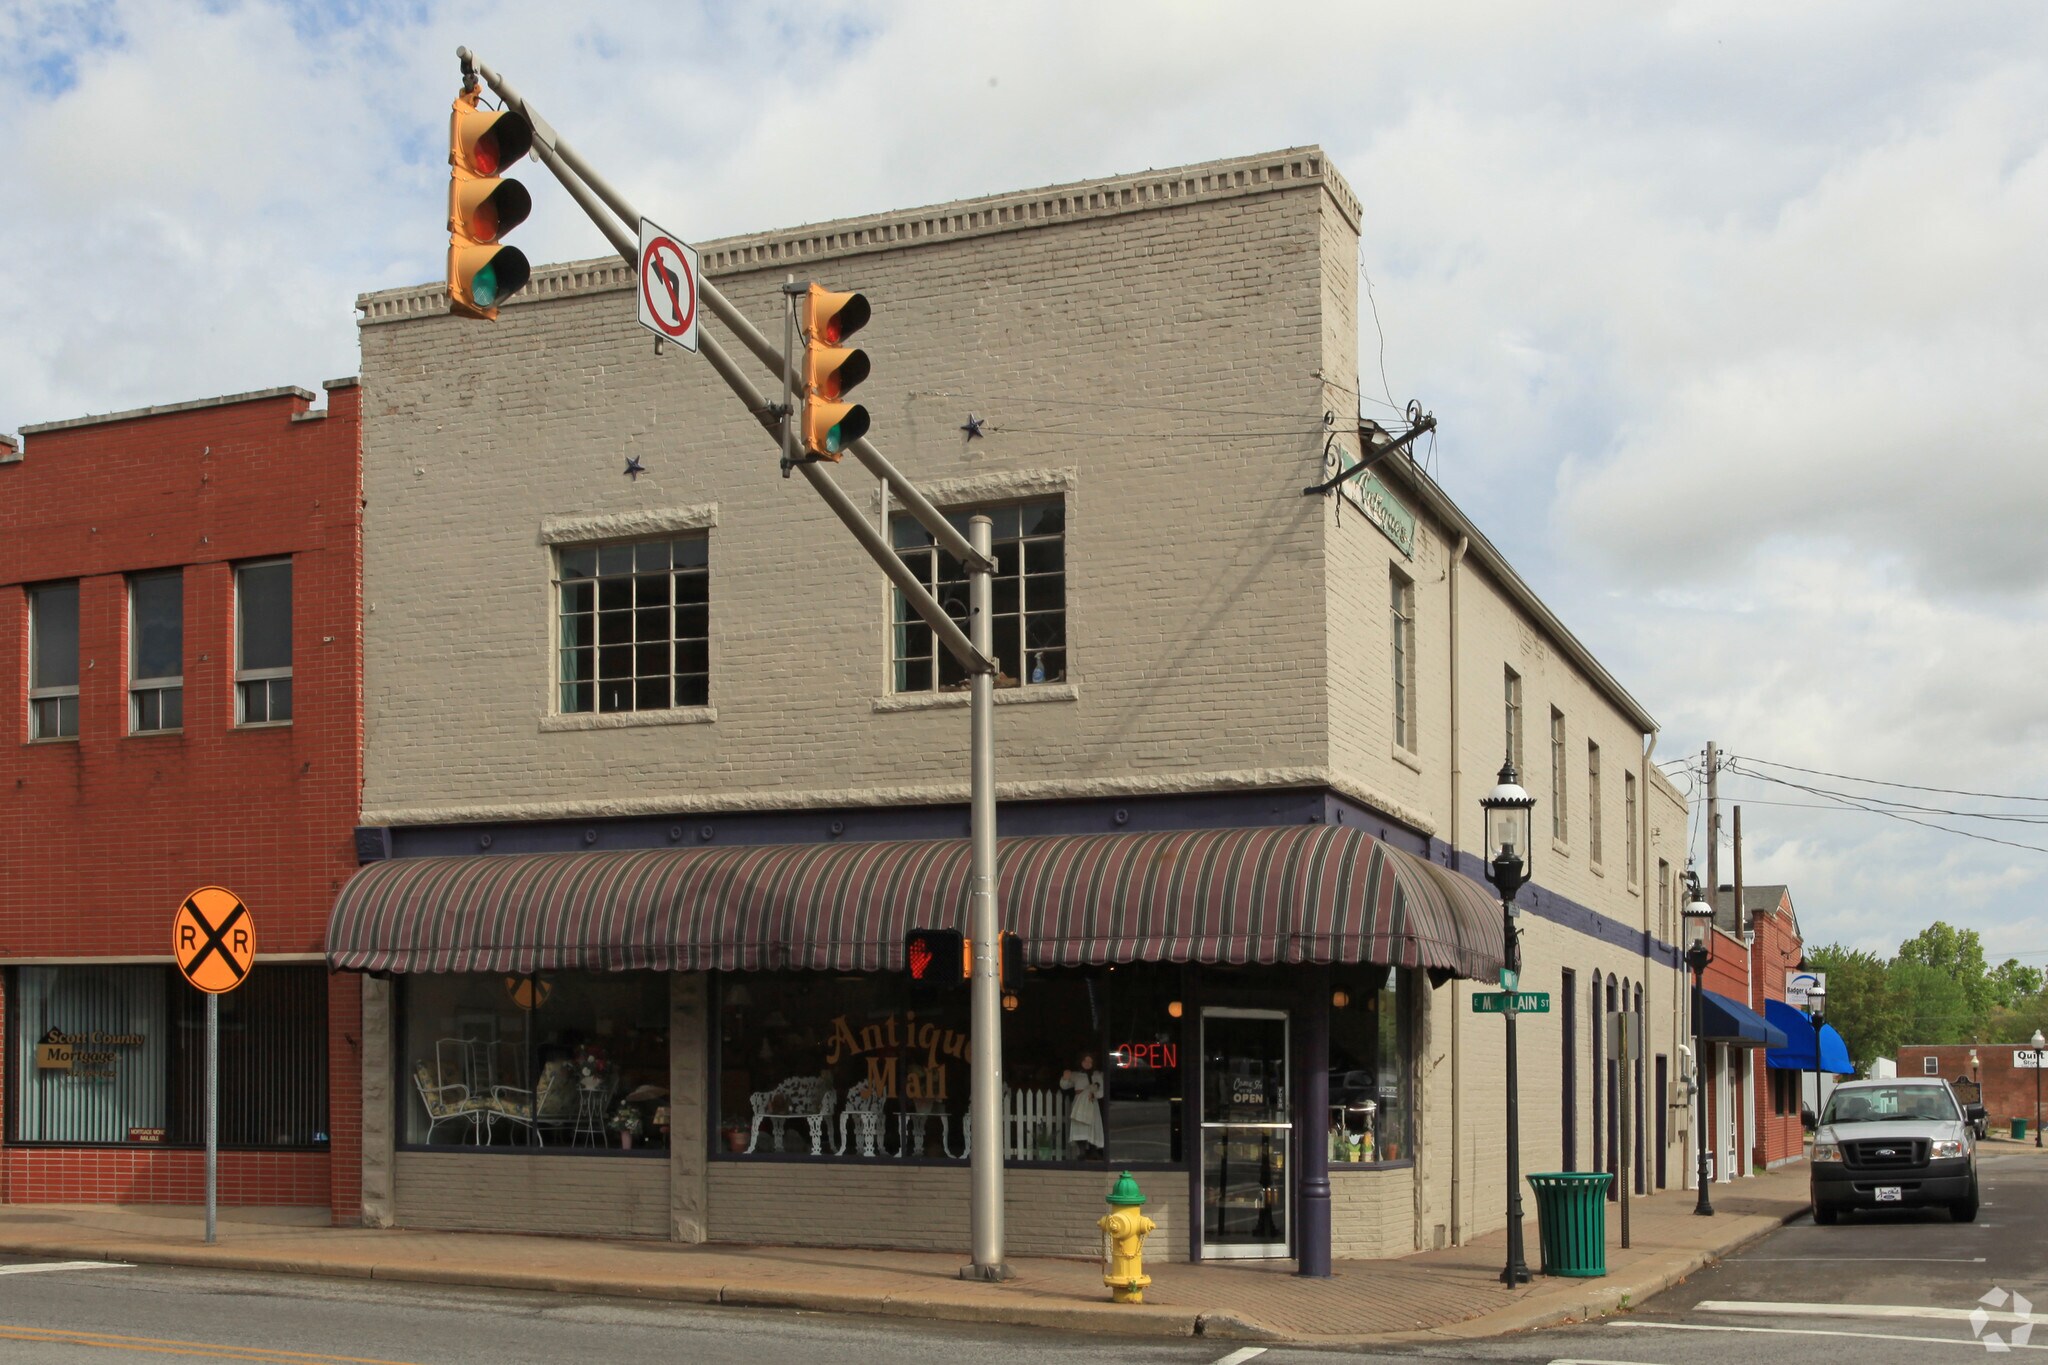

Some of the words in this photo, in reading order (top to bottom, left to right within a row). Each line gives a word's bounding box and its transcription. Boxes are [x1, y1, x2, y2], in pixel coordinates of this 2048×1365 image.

[181, 925, 196, 950] R
[234, 929, 248, 953] R
[1482, 995, 1537, 1010] MLAIN
[1541, 1000, 1549, 1008] ST
[48, 1030, 88, 1044] Scott
[91, 1030, 145, 1045] County
[47, 1048, 116, 1064] Mortgage
[1117, 1043, 1177, 1069] OPEN
[2018, 1051, 2045, 1060] Quit
[860, 1057, 948, 1099] Mall
[1233, 1093, 1264, 1104] OPEN
